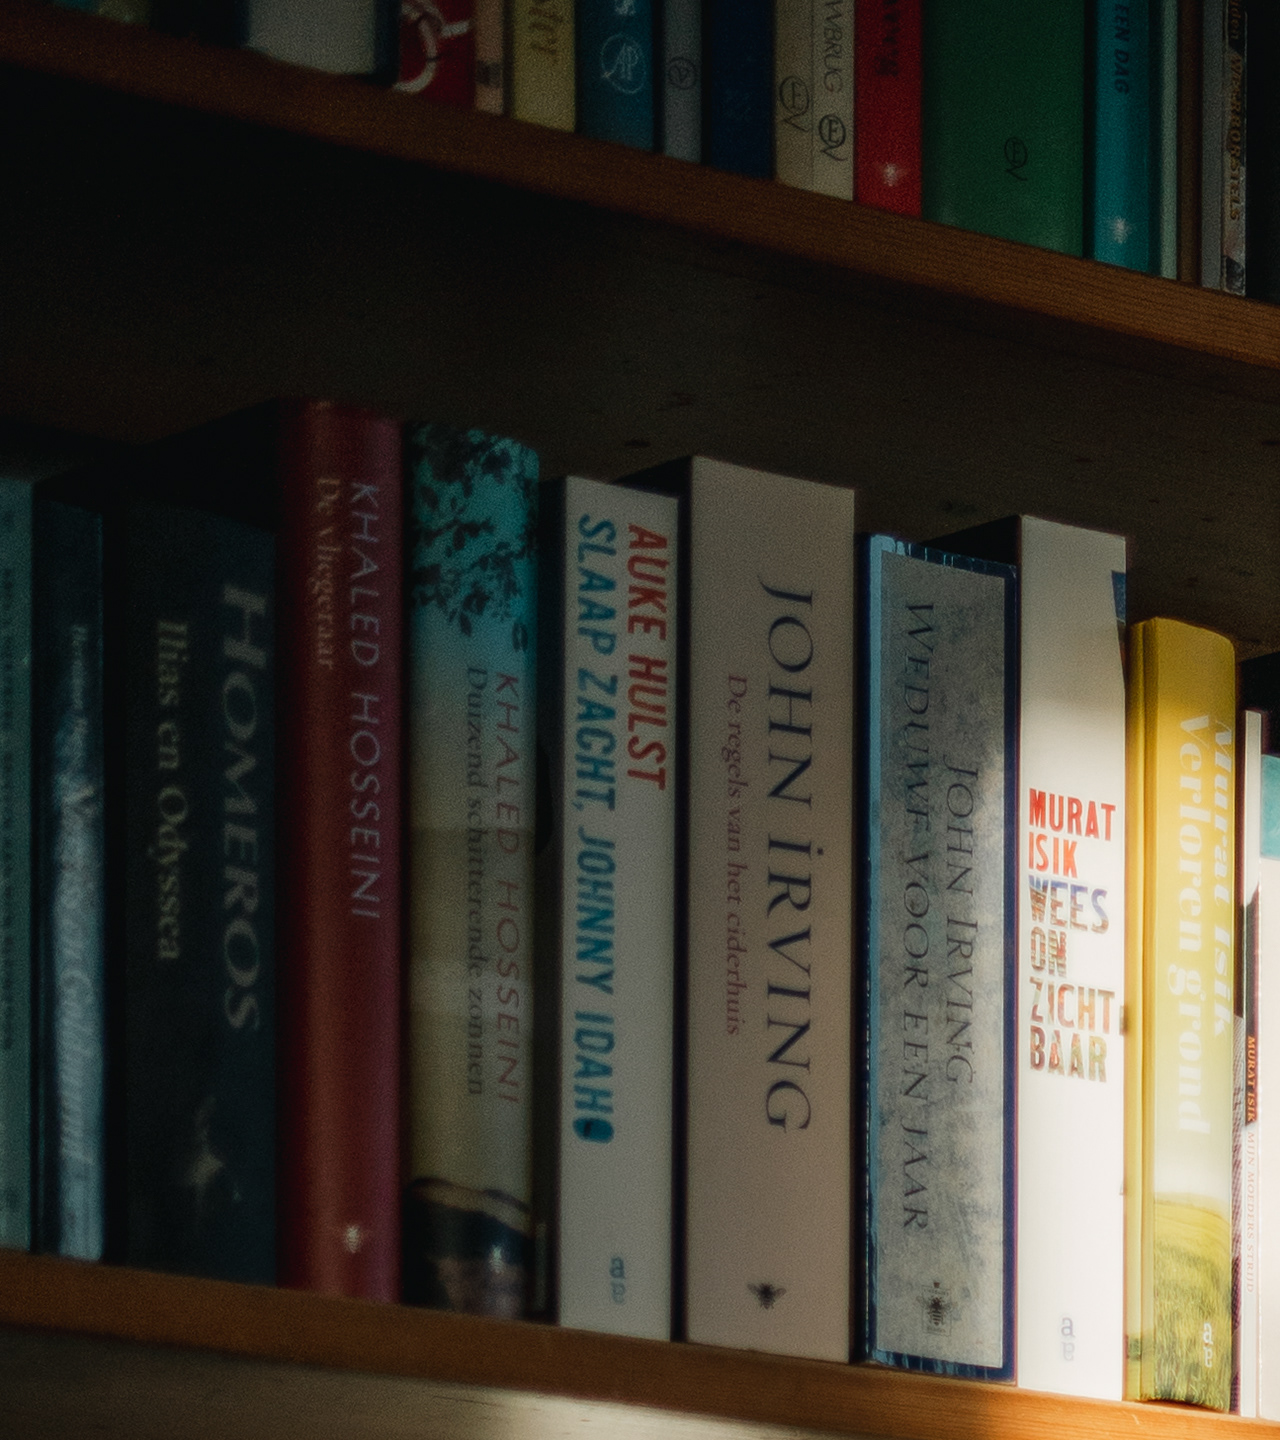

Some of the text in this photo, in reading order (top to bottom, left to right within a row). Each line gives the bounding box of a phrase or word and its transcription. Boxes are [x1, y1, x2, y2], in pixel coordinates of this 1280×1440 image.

[576, 512, 617, 660] SLAAP
[627, 523, 668, 791] AUKE HULST
[349, 482, 382, 921] KHALED HOSSEINI
[756, 572, 816, 812] JOHN
[150, 617, 191, 961] Ilias en Odyssea
[221, 581, 270, 1031] HOMEROS
[1027, 831, 1079, 880] ISIK
[1028, 788, 1117, 842] MURAT
[574, 824, 616, 996] JOHNNY
[1028, 875, 1109, 935] WEES
[1029, 926, 1069, 979] ON
[1168, 713, 1212, 1134] Verloren grond
[1028, 982, 1116, 1035] ZICHT
[1028, 1025, 1109, 1083] BAAR
